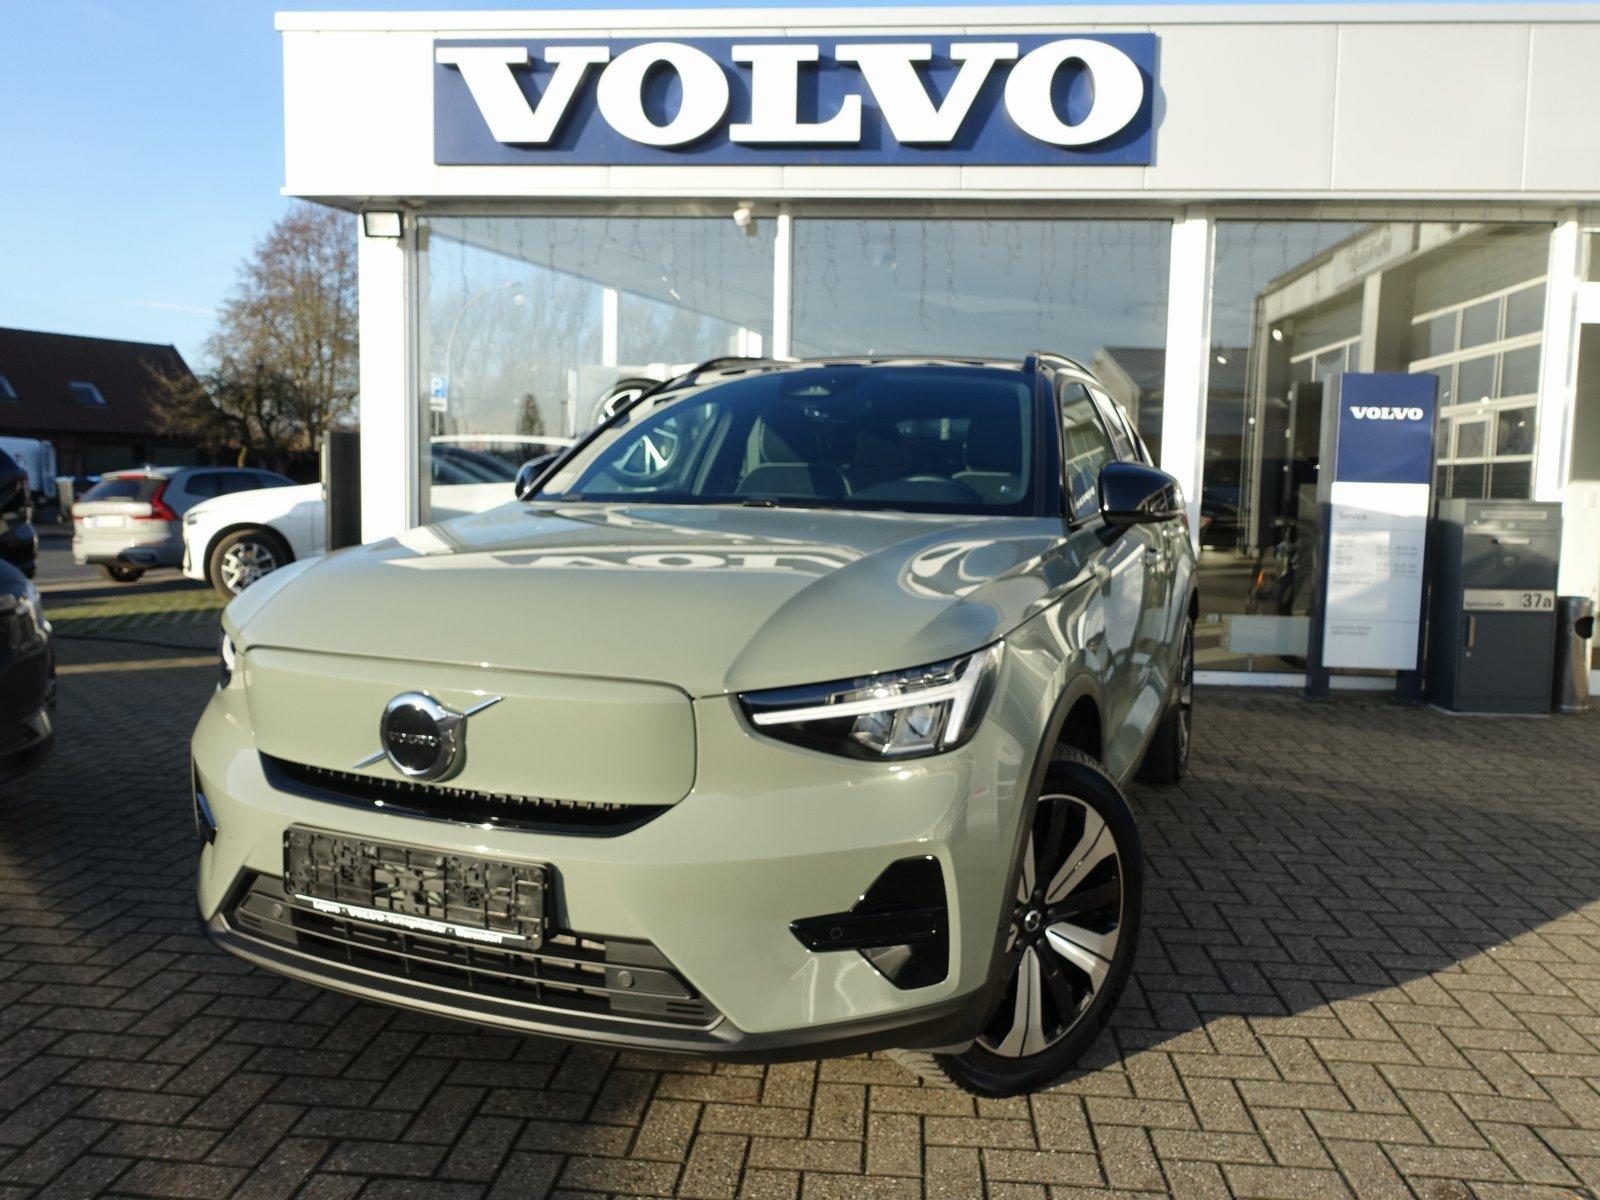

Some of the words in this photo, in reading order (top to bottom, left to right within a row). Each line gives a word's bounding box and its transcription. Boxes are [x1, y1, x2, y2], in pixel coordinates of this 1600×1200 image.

[436, 39, 1145, 148] VOLVO
[1349, 406, 1424, 420] VOLVO
[1522, 593, 1552, 608] 37a
